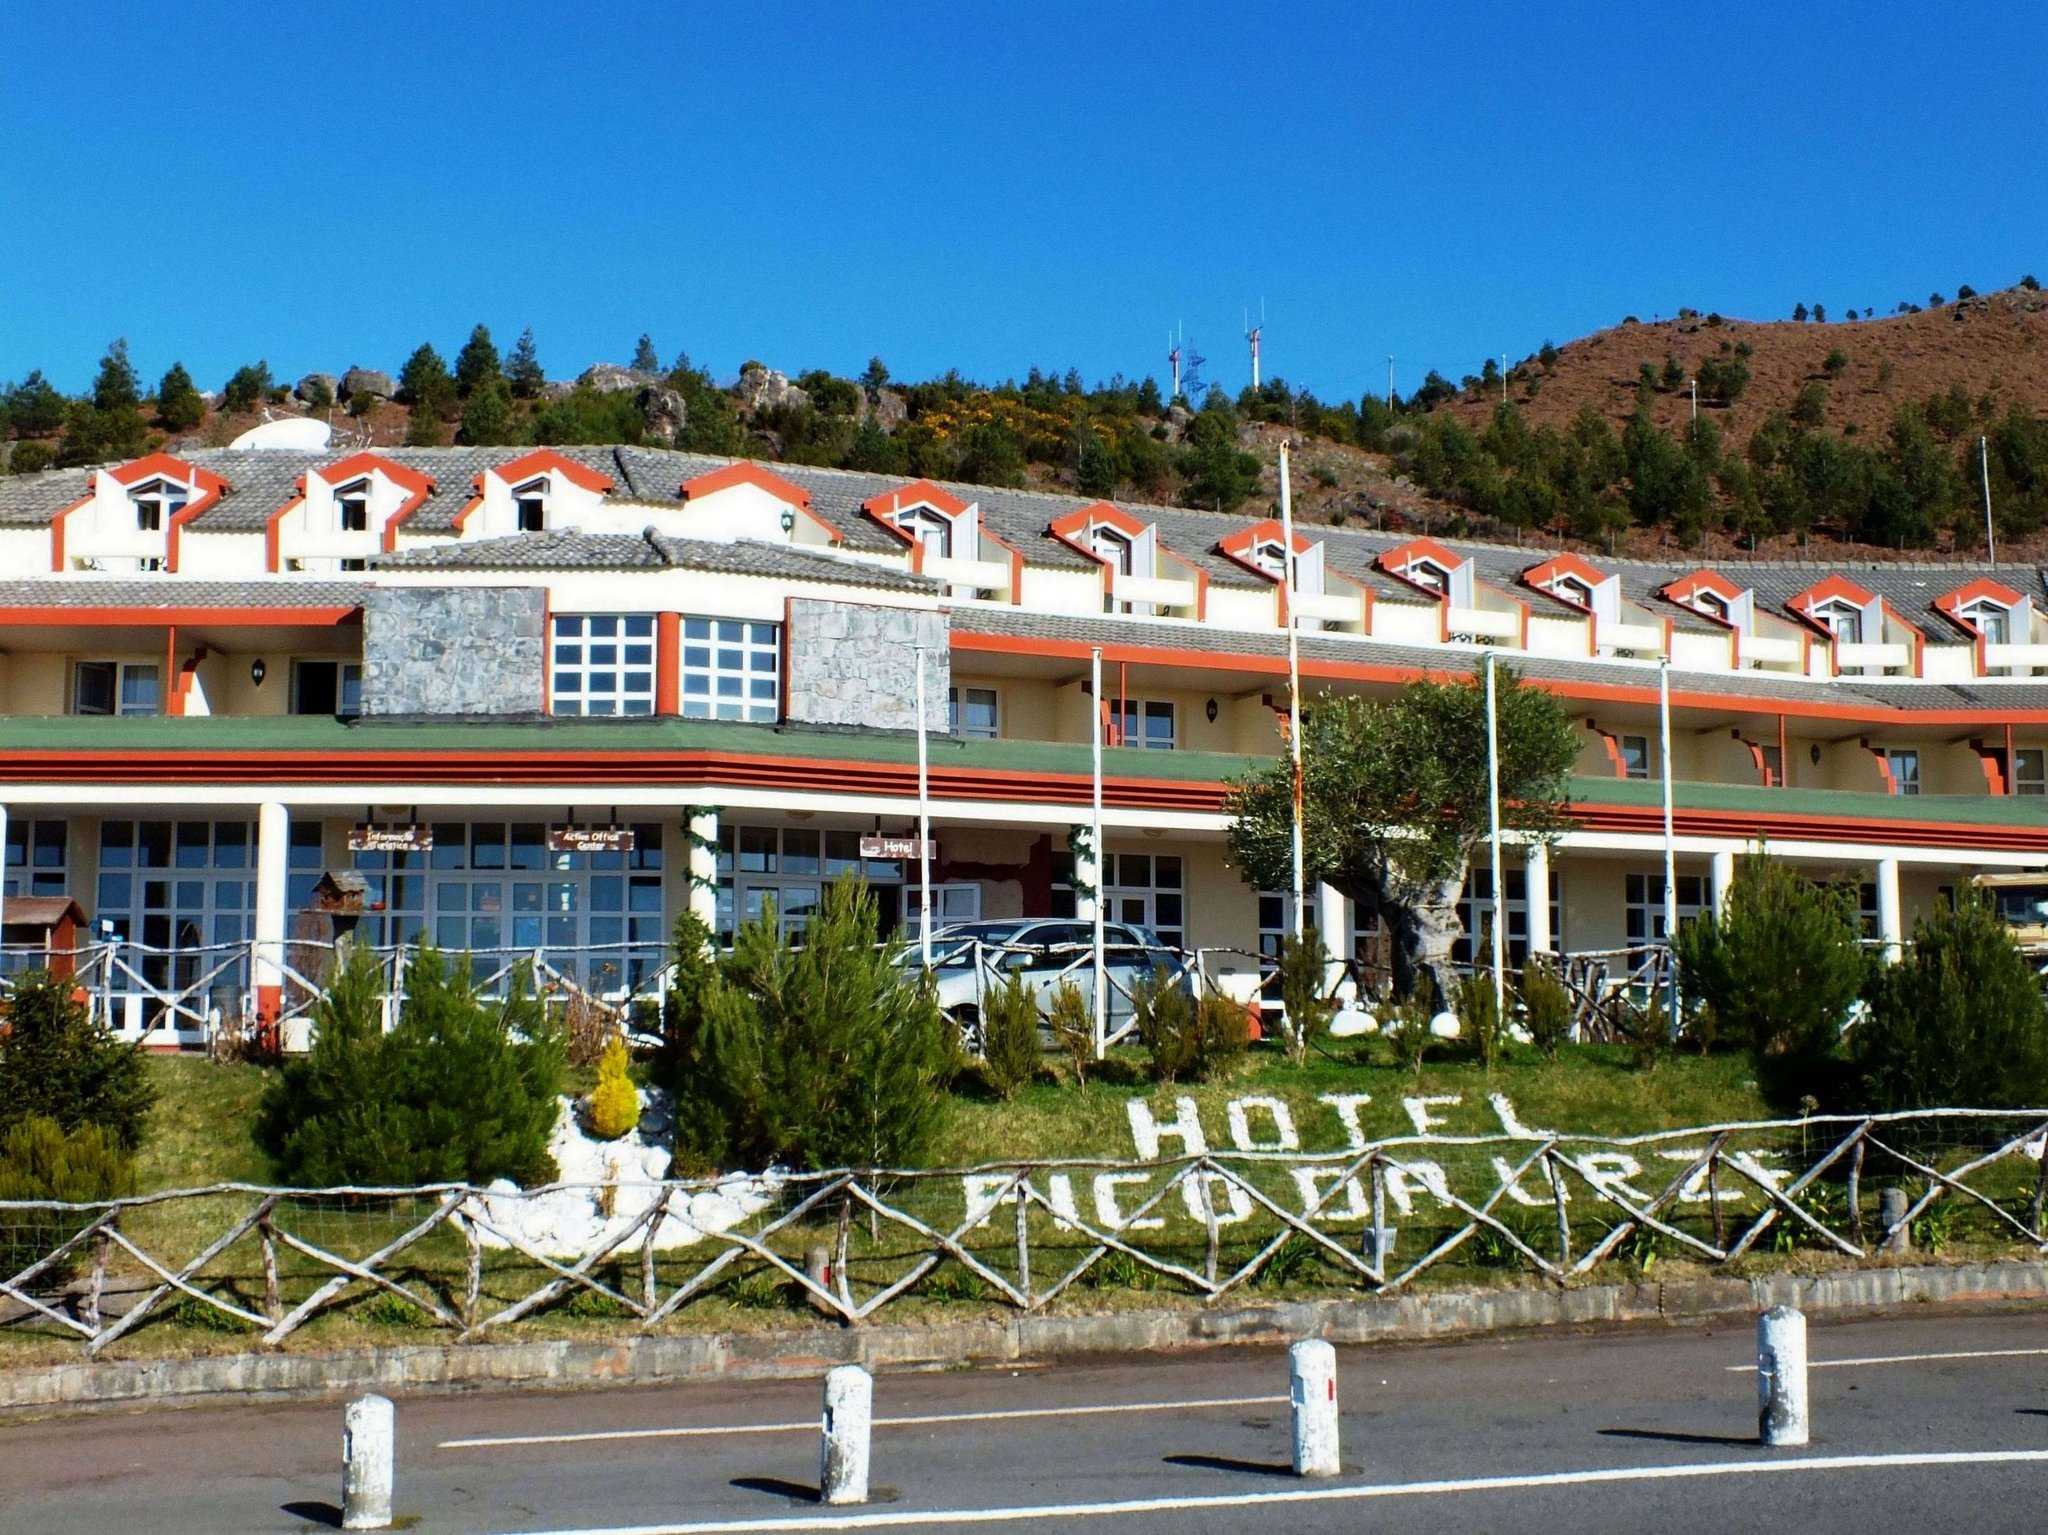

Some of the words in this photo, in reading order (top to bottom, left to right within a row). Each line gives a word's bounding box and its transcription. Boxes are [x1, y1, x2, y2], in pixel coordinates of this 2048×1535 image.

[591, 832, 620, 841] Office
[884, 840, 913, 853] Hotel
[1126, 1093, 1559, 1161] HOTEL
[963, 1170, 1255, 1232] PICO
